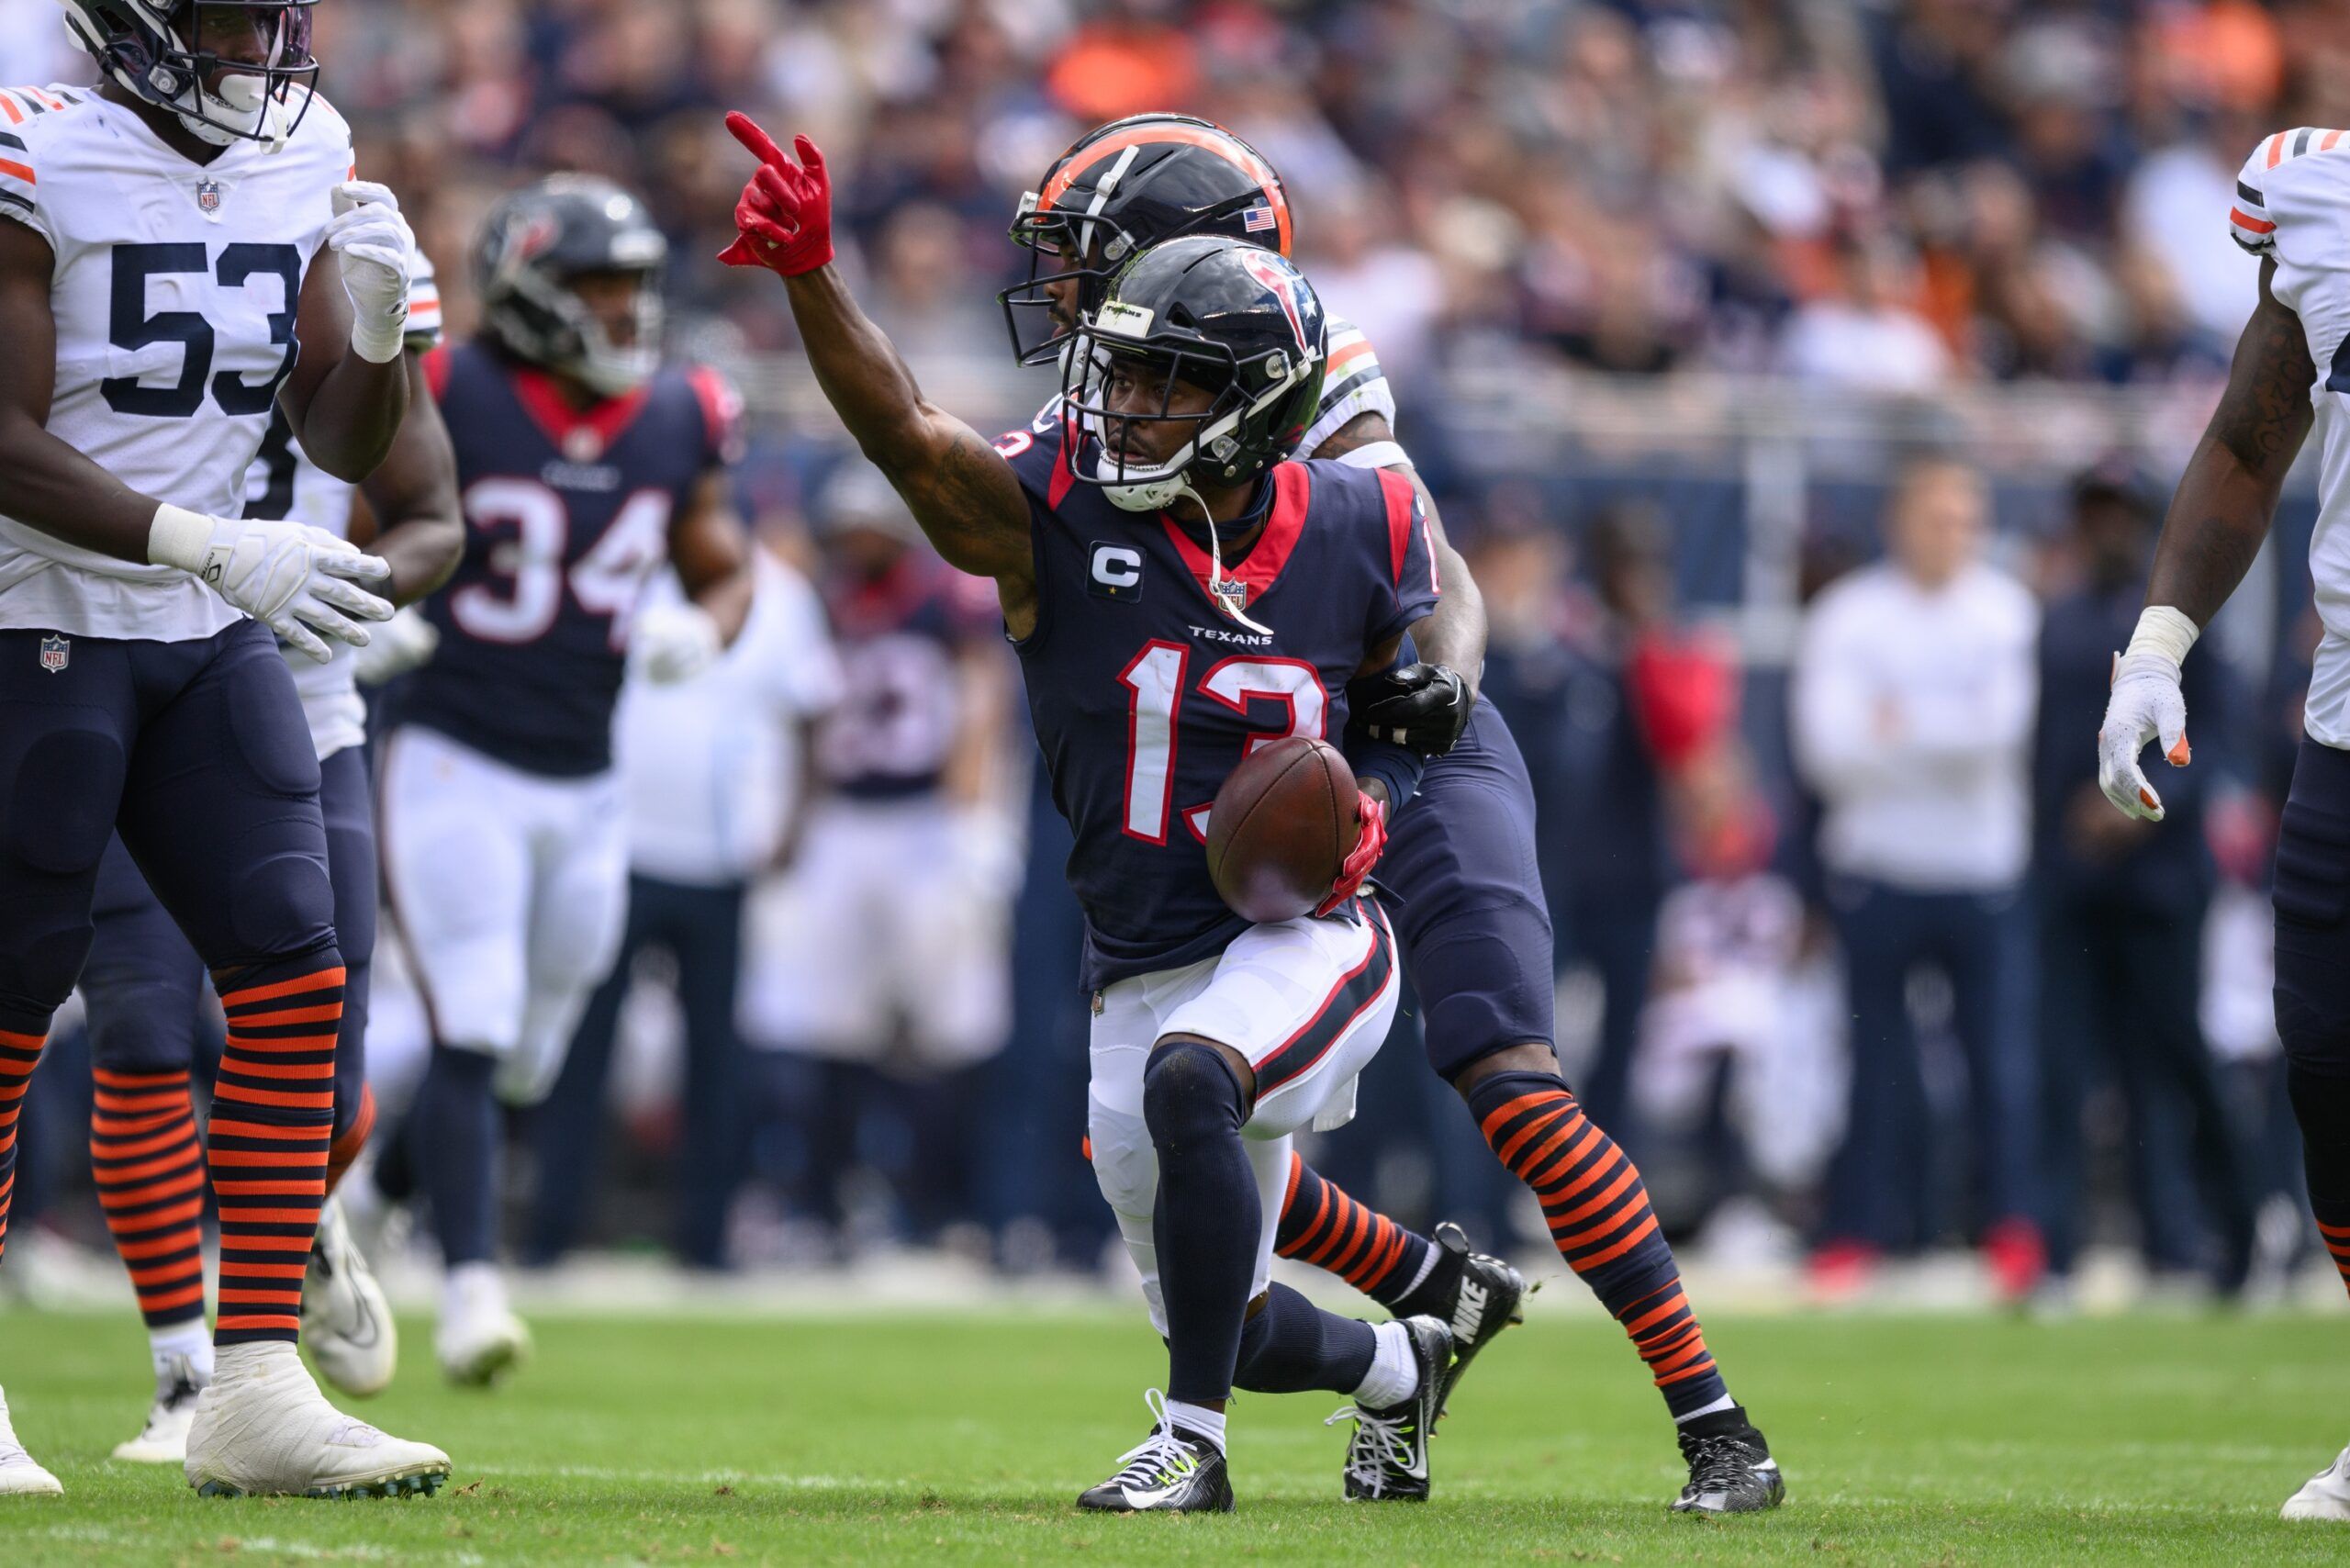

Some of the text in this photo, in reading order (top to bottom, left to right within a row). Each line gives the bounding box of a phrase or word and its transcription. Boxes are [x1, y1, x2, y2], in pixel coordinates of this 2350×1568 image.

[100, 242, 302, 417] 53
[450, 475, 674, 652] 34
[1091, 546, 1141, 588] C
[44, 651, 65, 666] NFL
[1188, 624, 1273, 645] TEXANS
[1450, 1275, 1488, 1345] NIKE
